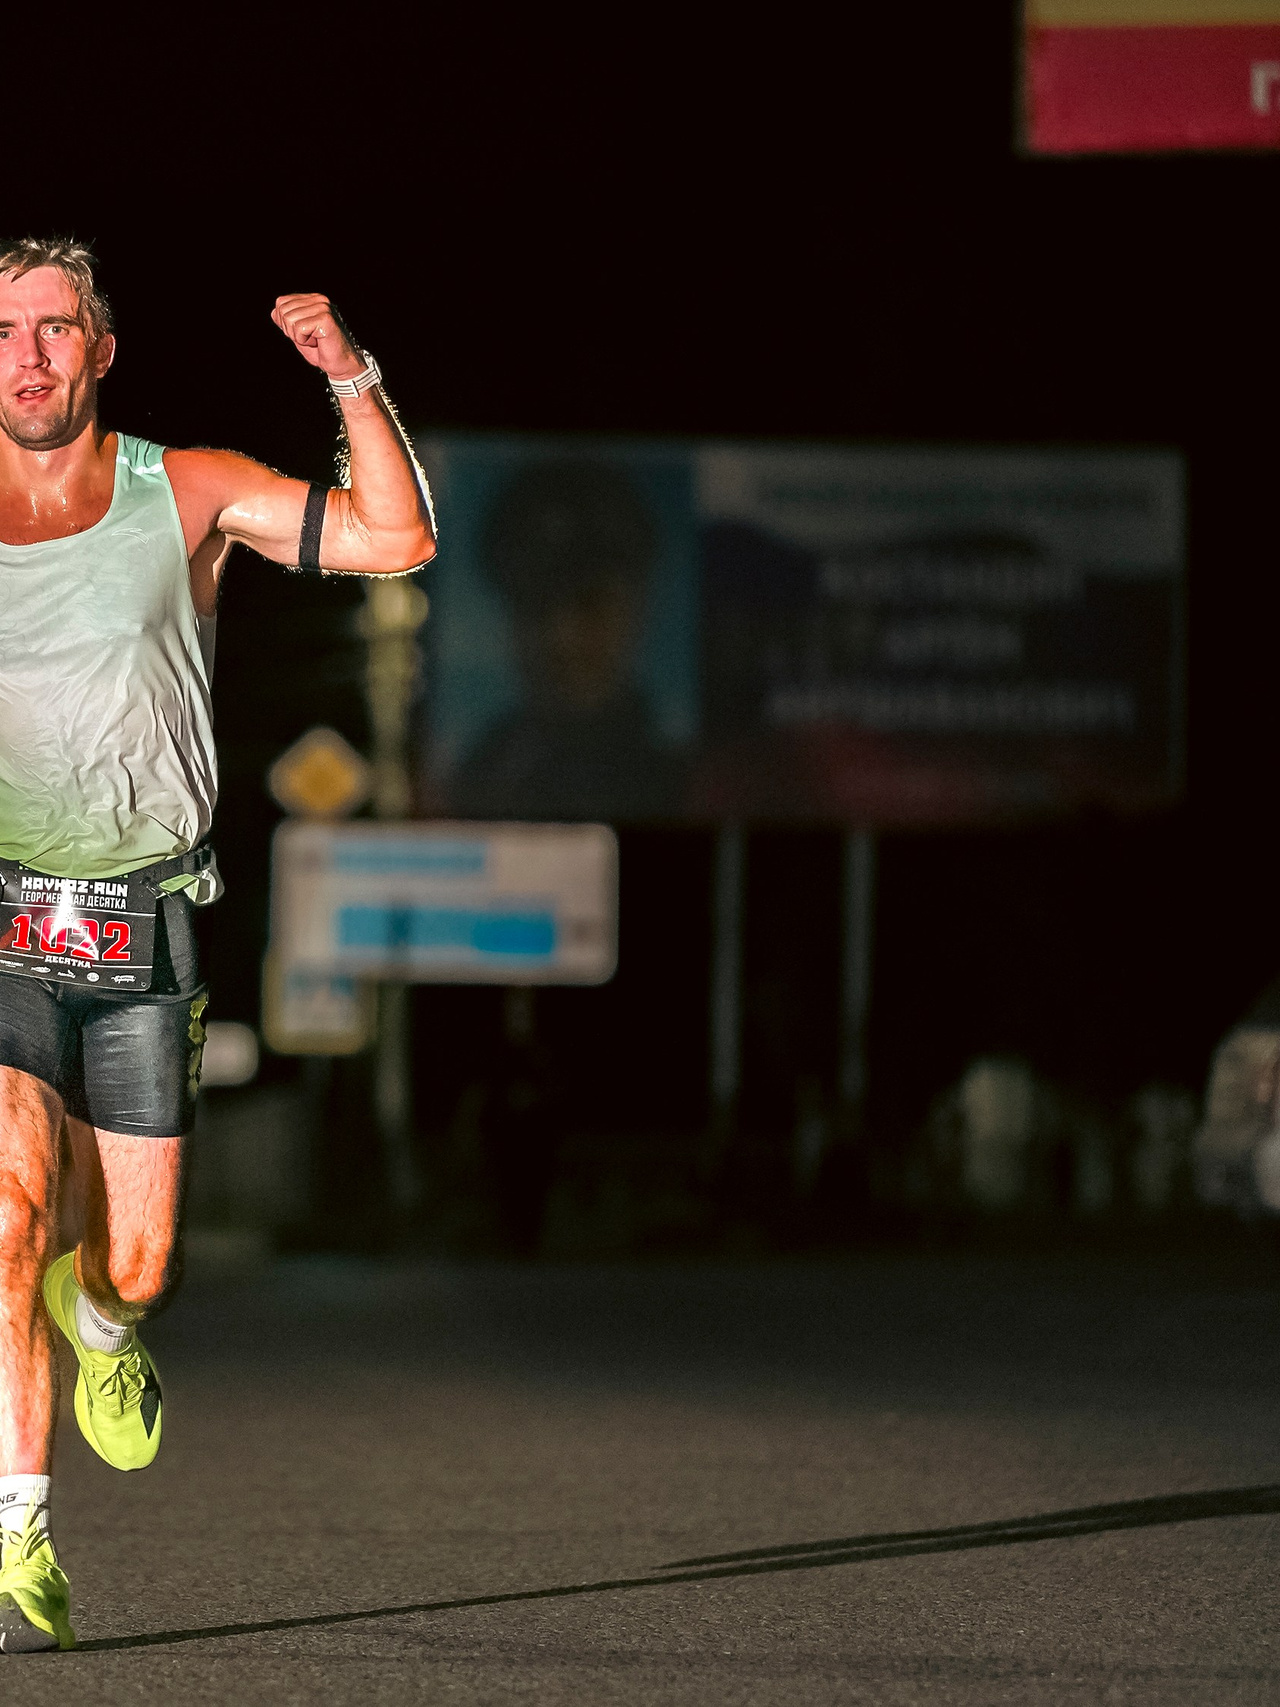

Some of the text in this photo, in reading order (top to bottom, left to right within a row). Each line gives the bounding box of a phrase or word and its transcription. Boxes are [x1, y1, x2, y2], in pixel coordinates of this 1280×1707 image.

[20, 891, 127, 910] ГЕОРГИЕВАЯ ДЕСЯТКА
[11, 913, 131, 961] 1022
[44, 955, 92, 969] ДЕСЯТКА
